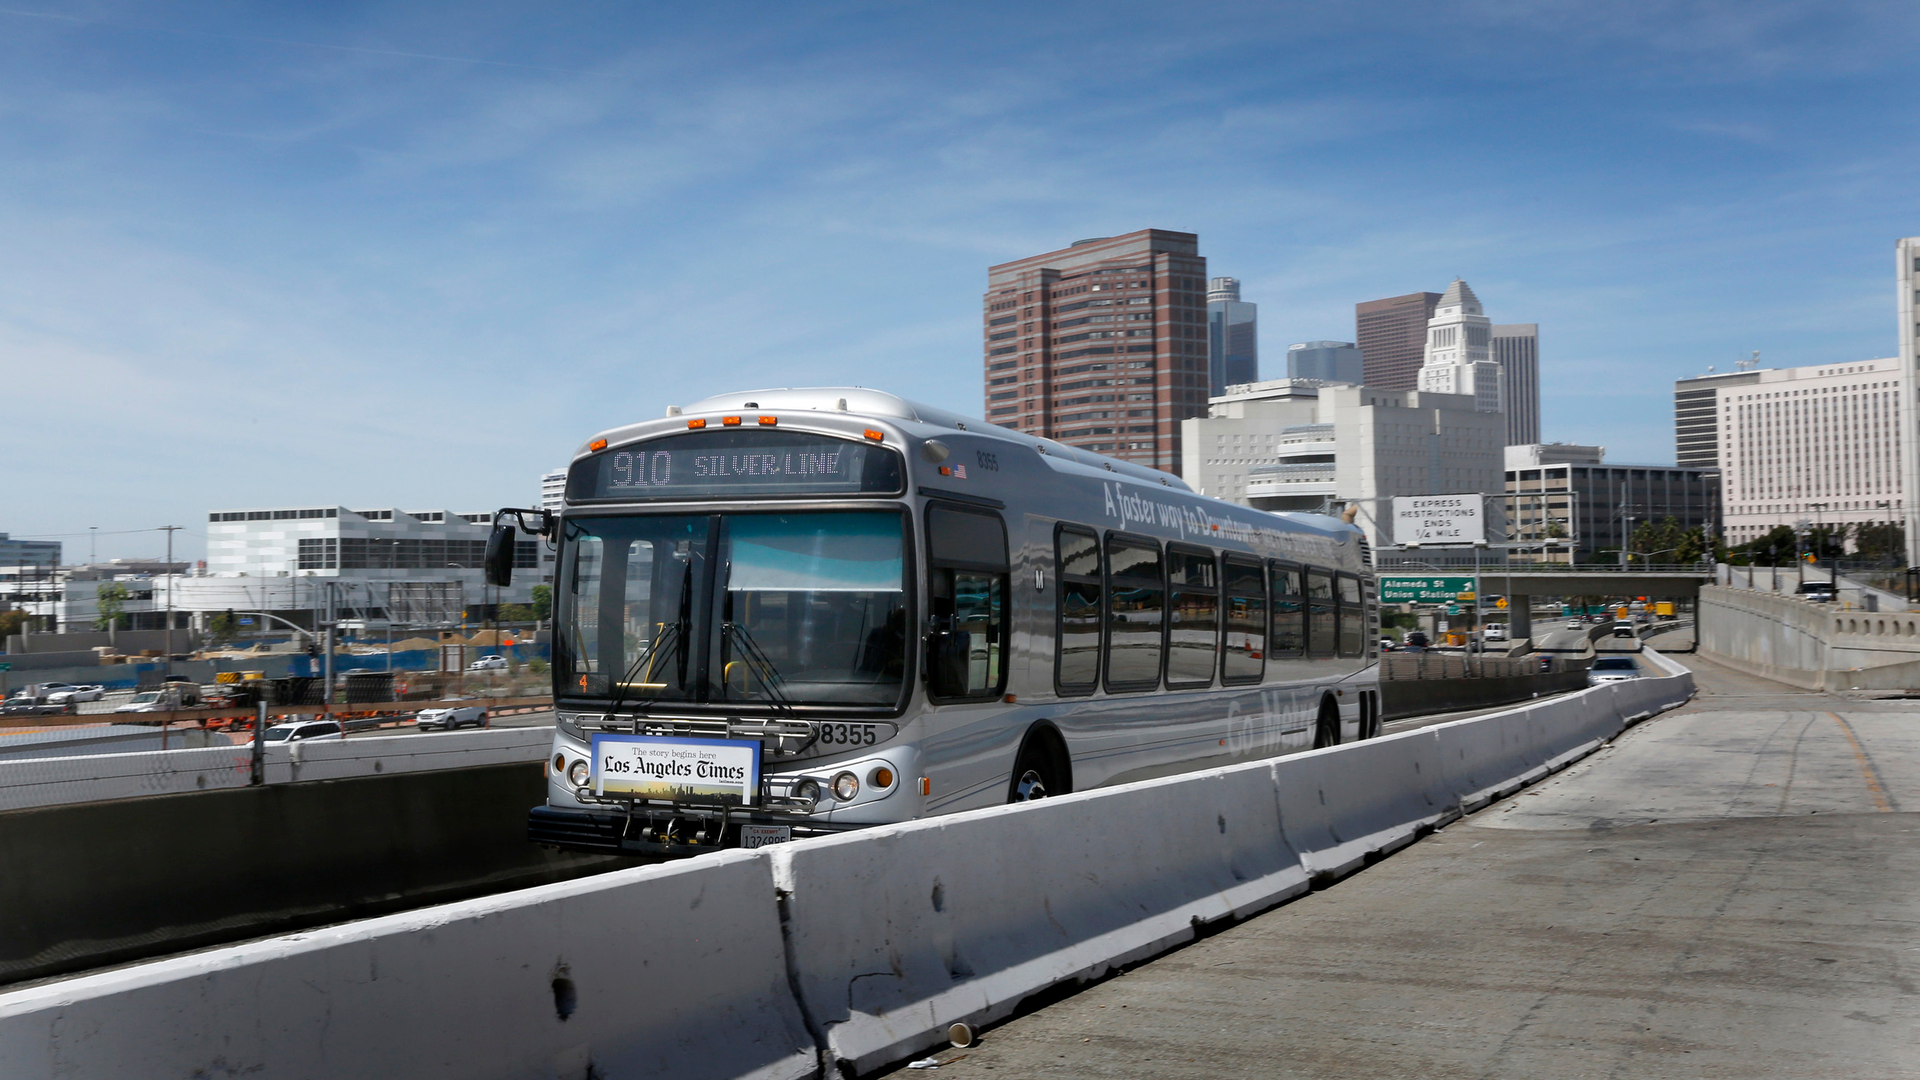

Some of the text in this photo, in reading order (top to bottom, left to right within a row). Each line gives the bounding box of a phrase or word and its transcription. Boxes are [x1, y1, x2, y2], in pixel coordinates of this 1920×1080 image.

[976, 450, 999, 472] 8355
[613, 451, 839, 486] 910 SILVER LINE
[1413, 499, 1462, 508] EXPRESS
[1103, 482, 1117, 517] A
[1116, 482, 1156, 531] faster
[1156, 502, 1185, 540] way
[1182, 504, 1199, 535] to
[1400, 509, 1475, 518] RESTRICTIONS
[1424, 520, 1452, 528] ENDS
[1436, 529, 1461, 537] MILE
[1384, 580, 1445, 588] Alameda St
[1419, 590, 1456, 598] Station
[821, 723, 876, 745] 8355
[632, 747, 717, 759] The story begins here
[604, 755, 744, 779] Los Angeles Times
